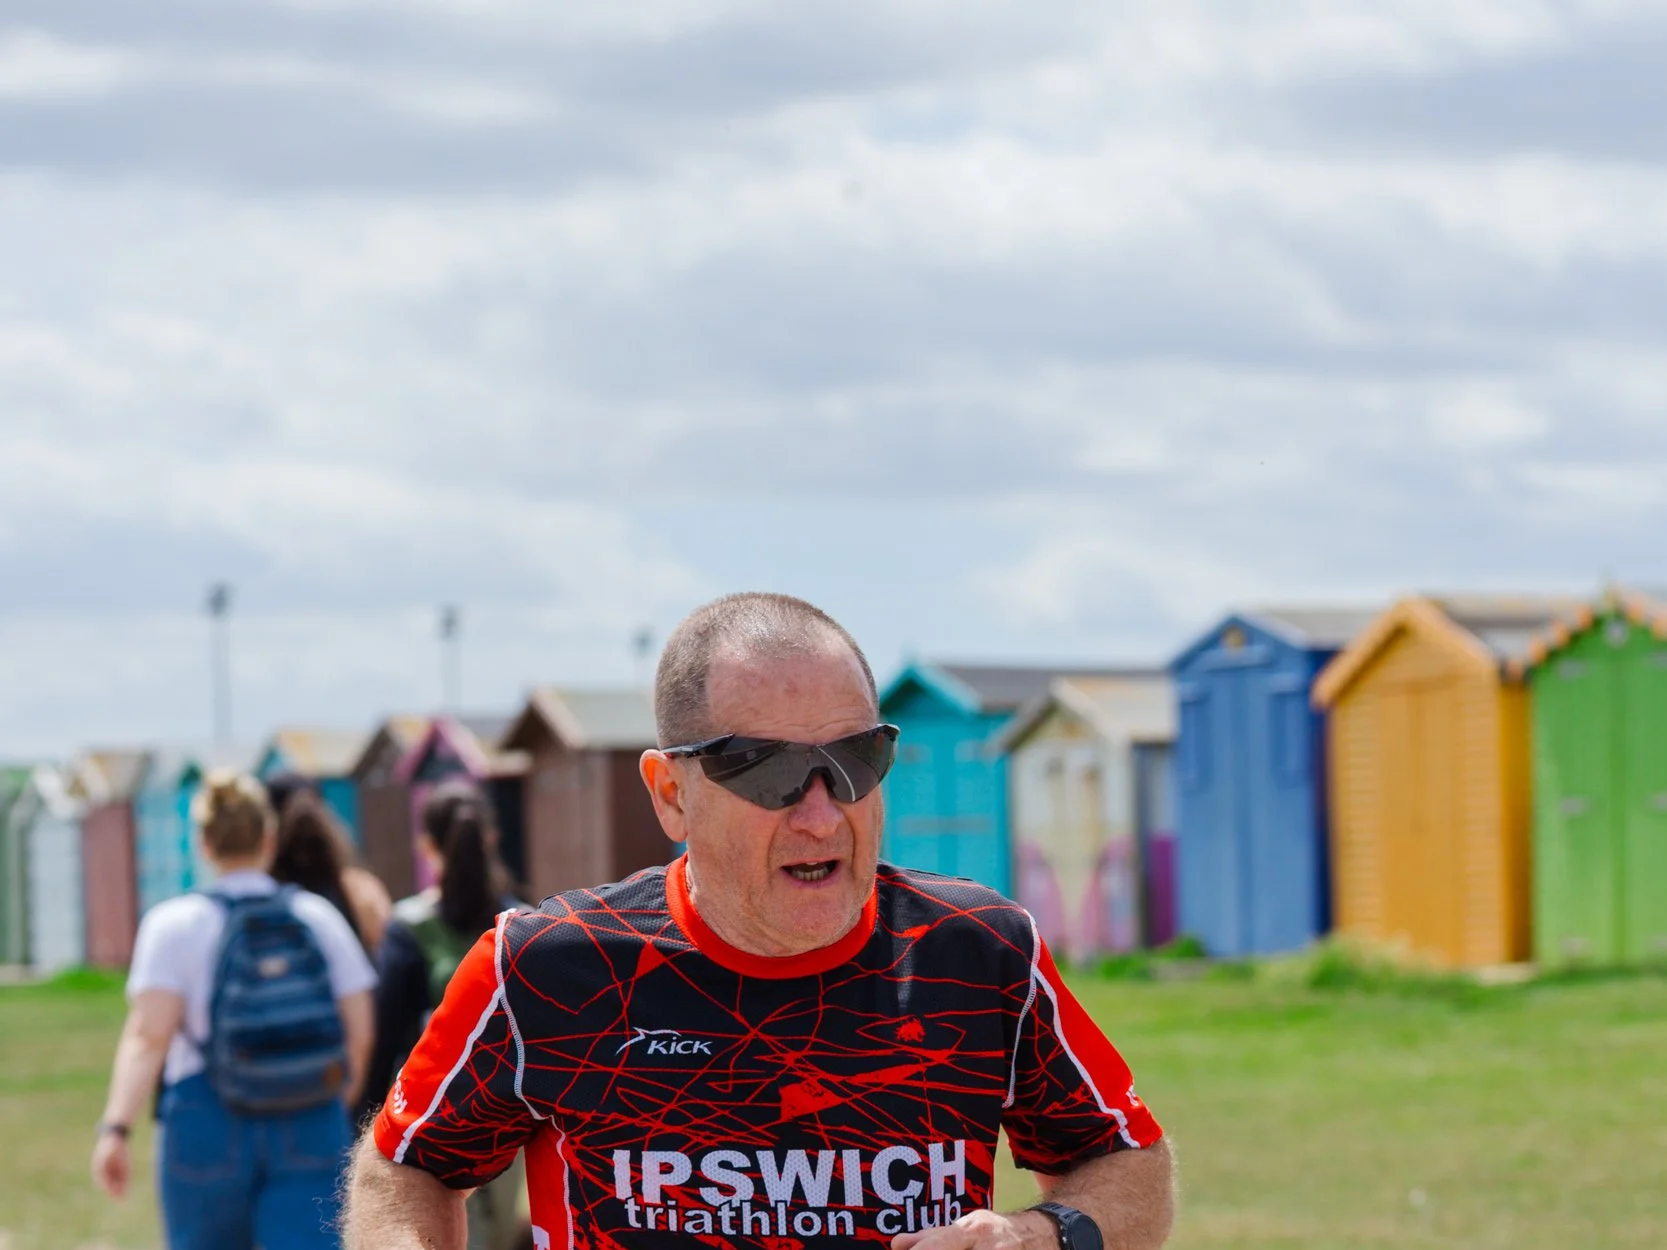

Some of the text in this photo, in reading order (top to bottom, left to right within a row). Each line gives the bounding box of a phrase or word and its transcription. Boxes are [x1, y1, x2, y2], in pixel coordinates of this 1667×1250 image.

[613, 1139, 965, 1207] IPSWICH
[624, 1193, 962, 1236] triathlon club
